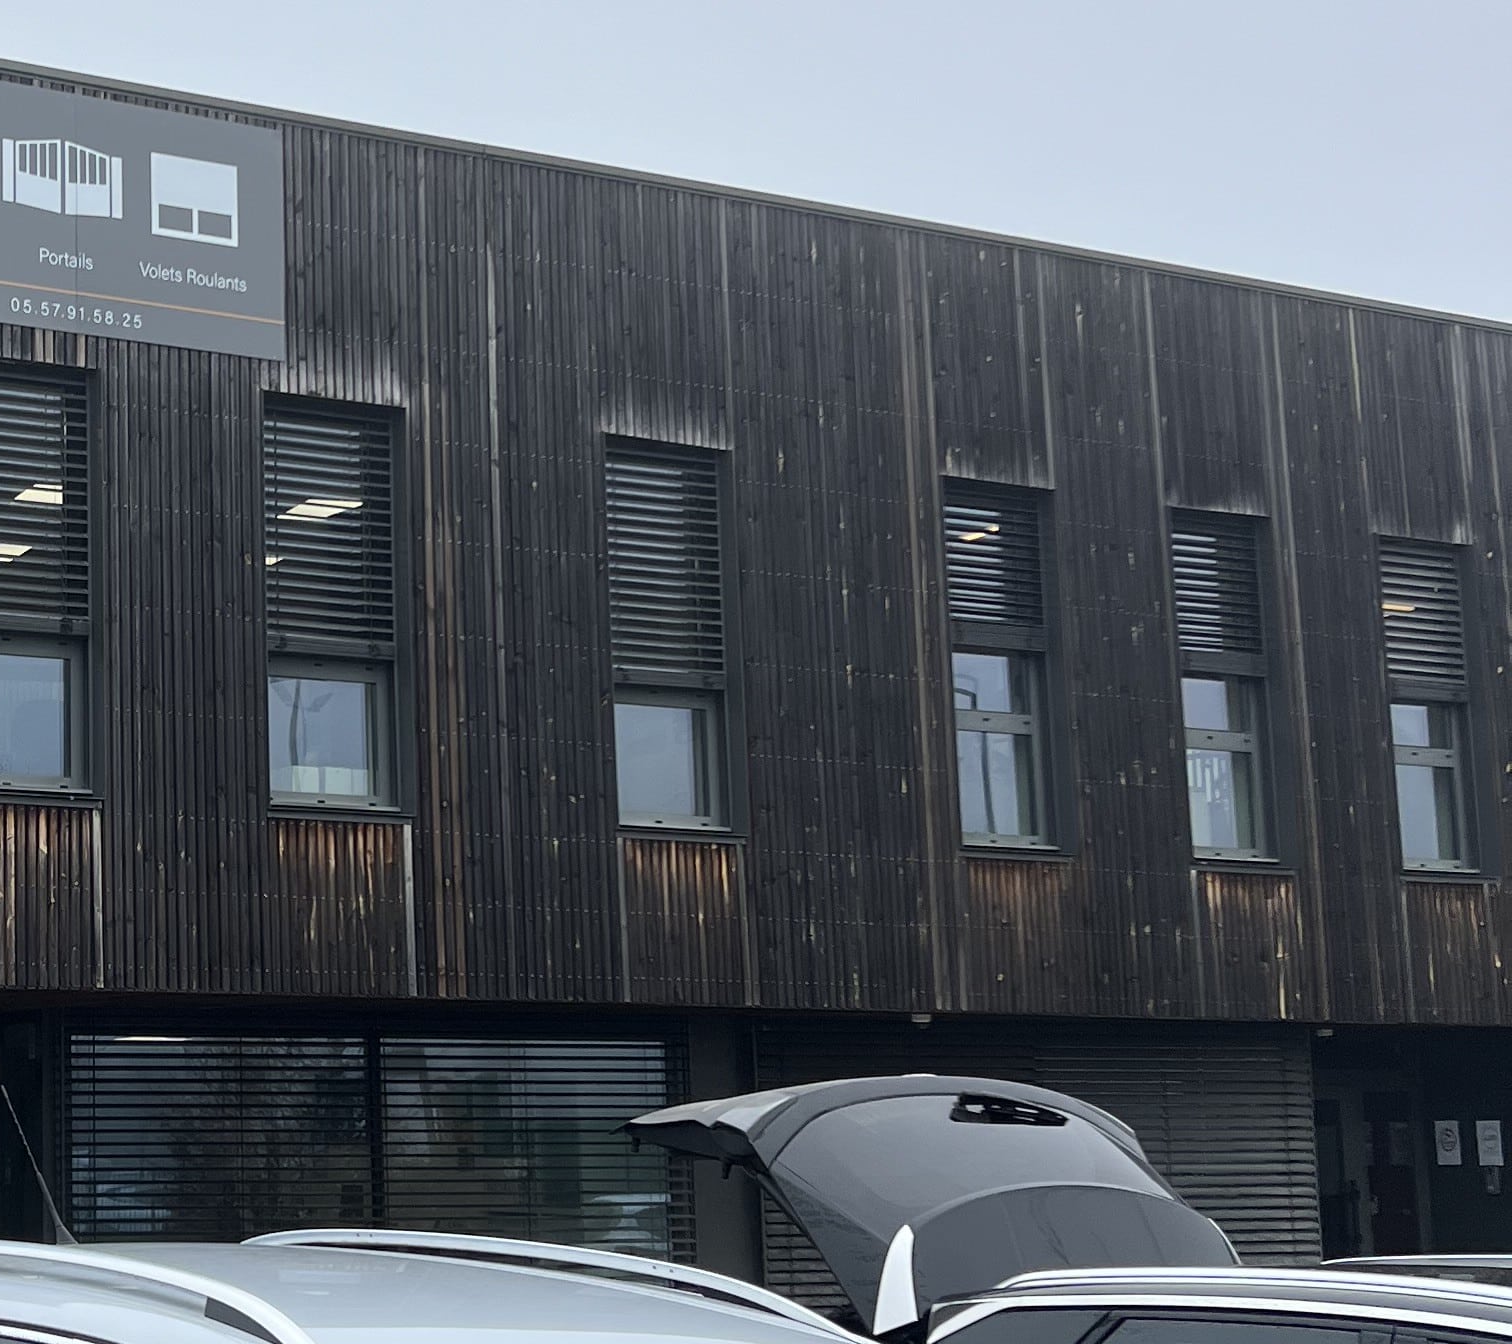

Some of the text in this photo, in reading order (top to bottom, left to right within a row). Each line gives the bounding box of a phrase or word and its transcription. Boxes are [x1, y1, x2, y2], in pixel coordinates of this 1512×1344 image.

[38, 246, 94, 271] Portails
[139, 260, 248, 293] Volets Roulants
[10, 296, 143, 329] 05.57.91.58.25
